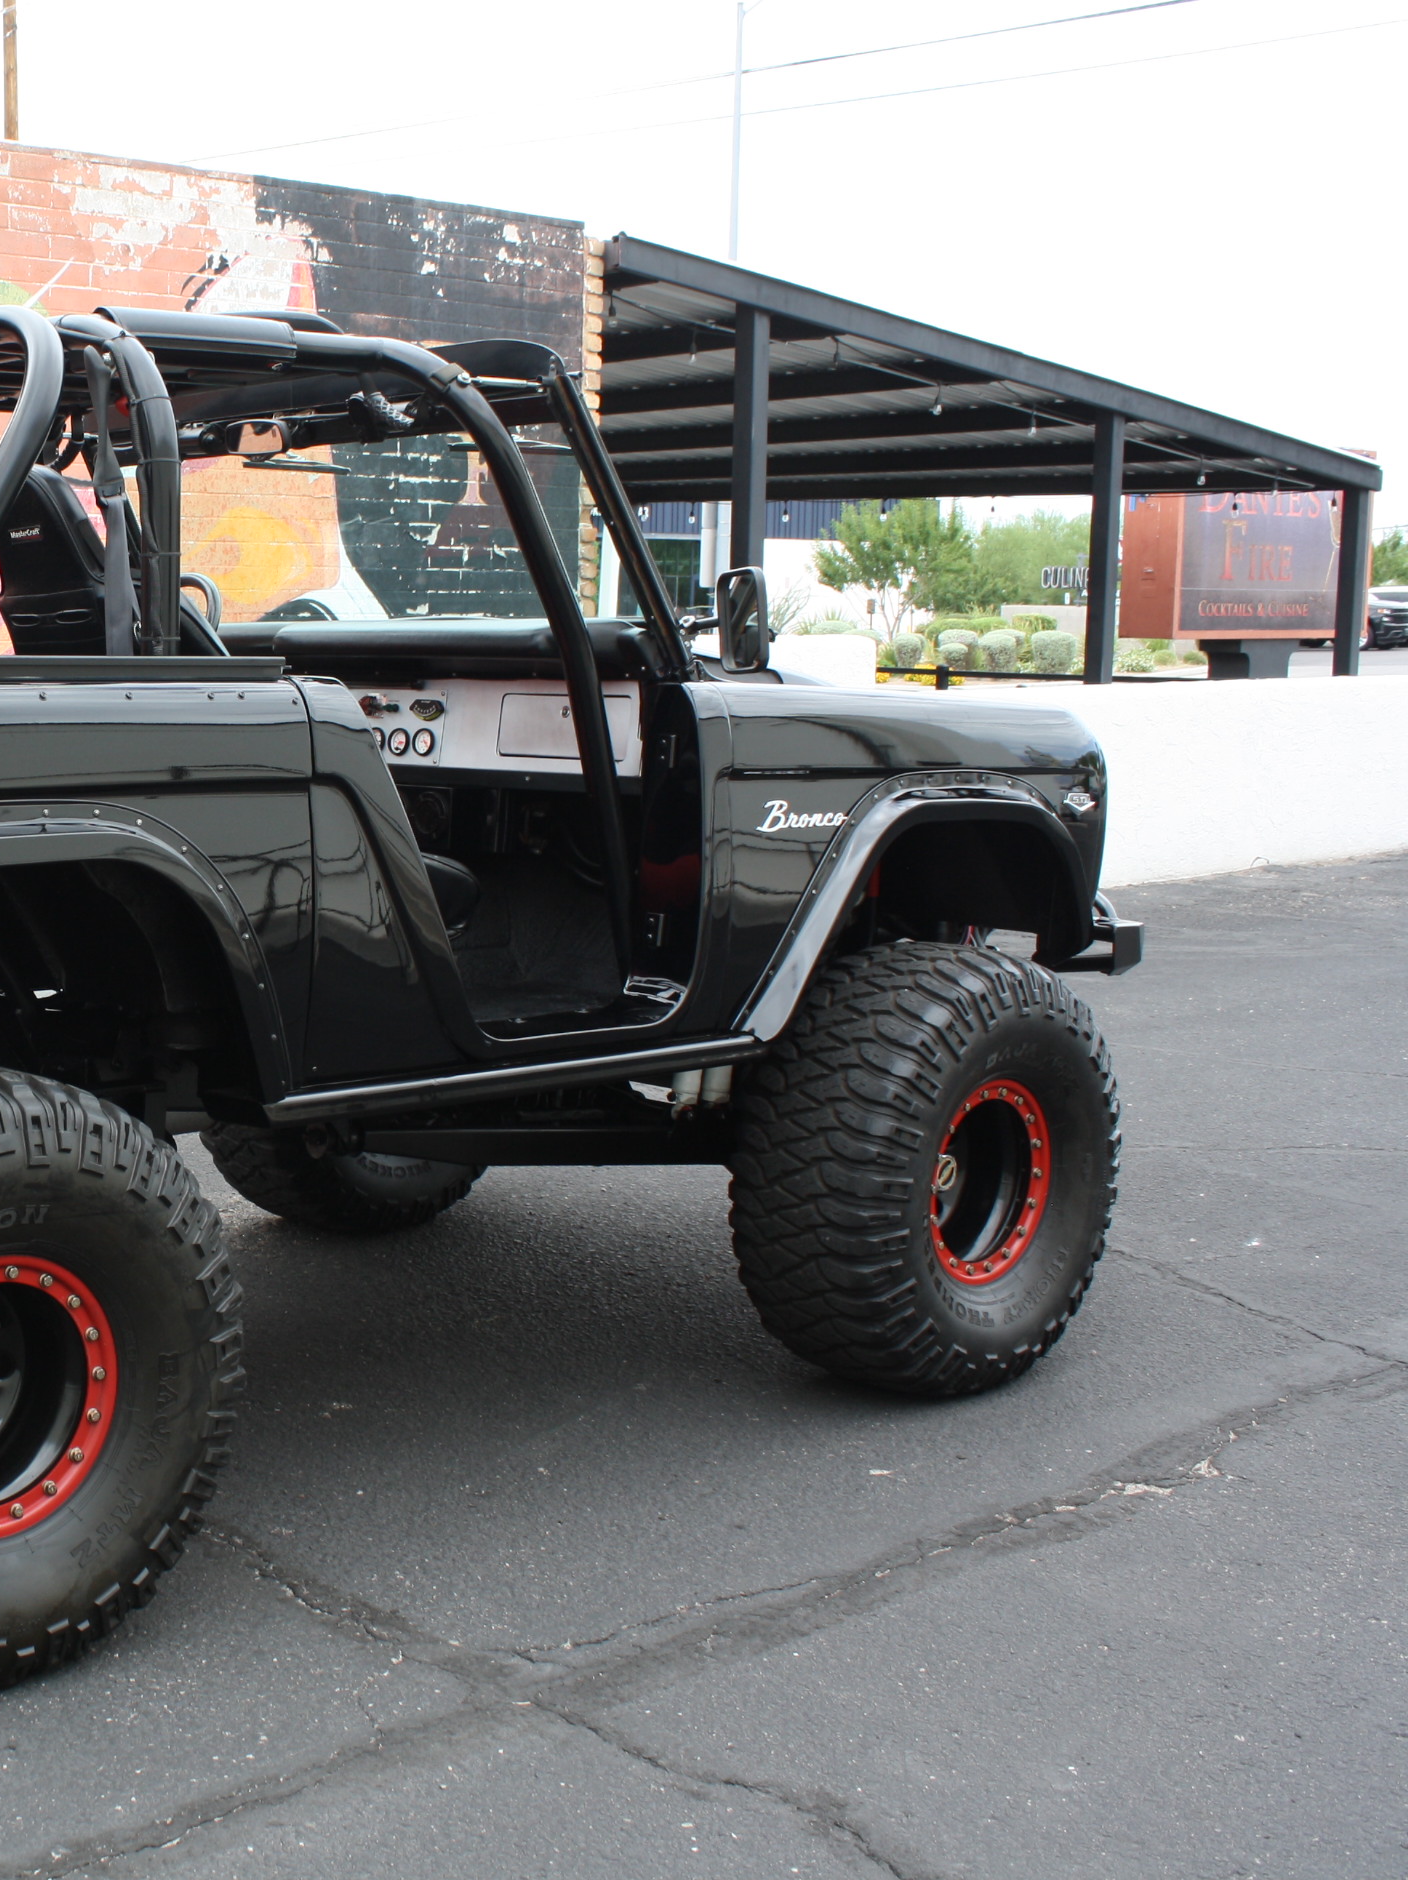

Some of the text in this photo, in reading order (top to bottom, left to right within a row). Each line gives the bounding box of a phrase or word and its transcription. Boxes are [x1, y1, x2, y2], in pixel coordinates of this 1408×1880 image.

[1219, 519, 1294, 582] FIRE
[1198, 600, 1310, 617] COCKTAILS & CUISINE
[756, 800, 849, 833] Bronco
